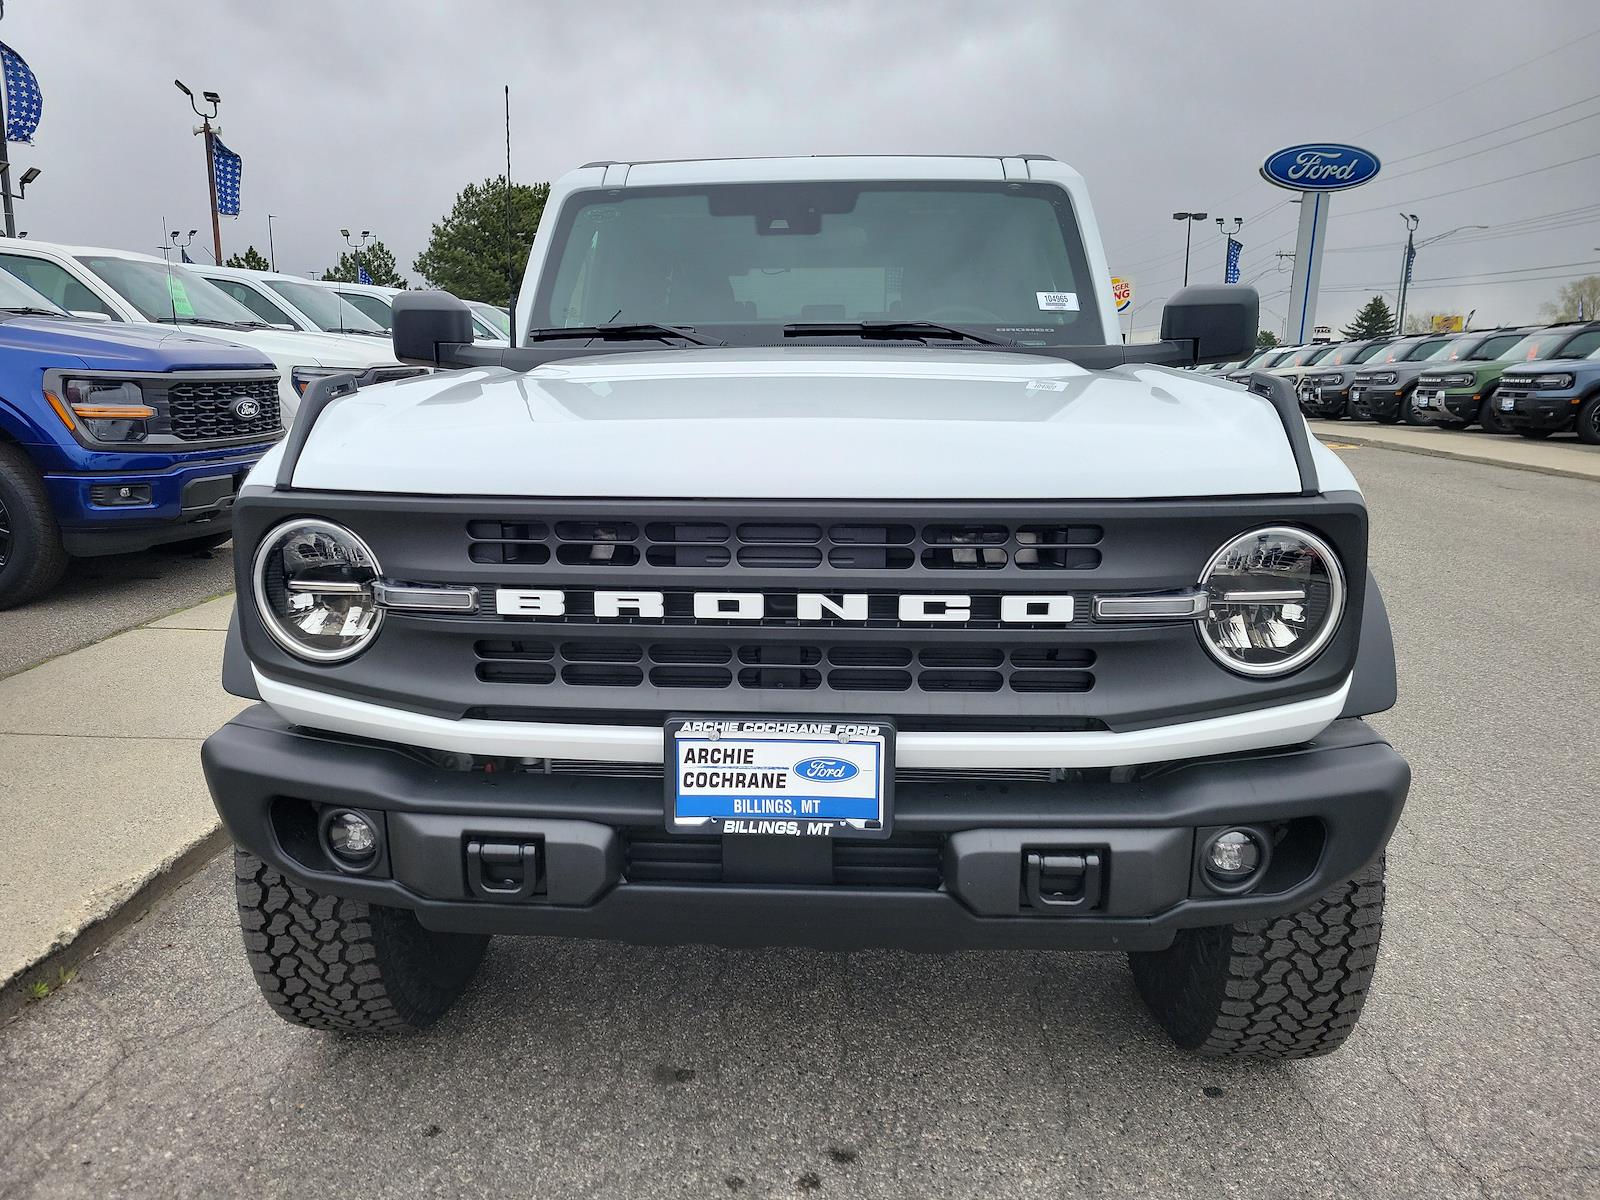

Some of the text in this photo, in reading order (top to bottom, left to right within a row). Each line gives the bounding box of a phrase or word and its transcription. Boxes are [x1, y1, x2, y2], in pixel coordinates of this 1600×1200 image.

[1287, 151, 1359, 180] Ford
[241, 402, 256, 415] Ford
[496, 588, 1075, 623] BRONCO
[680, 721, 880, 736] ARCHIE COCHRANE FORD
[683, 748, 754, 764] ARCHIE
[806, 760, 846, 778] Ford
[683, 771, 787, 789] COCHRANE
[733, 799, 821, 815] BILLINGS, MT
[723, 820, 834, 837] BILLINGS, MT
